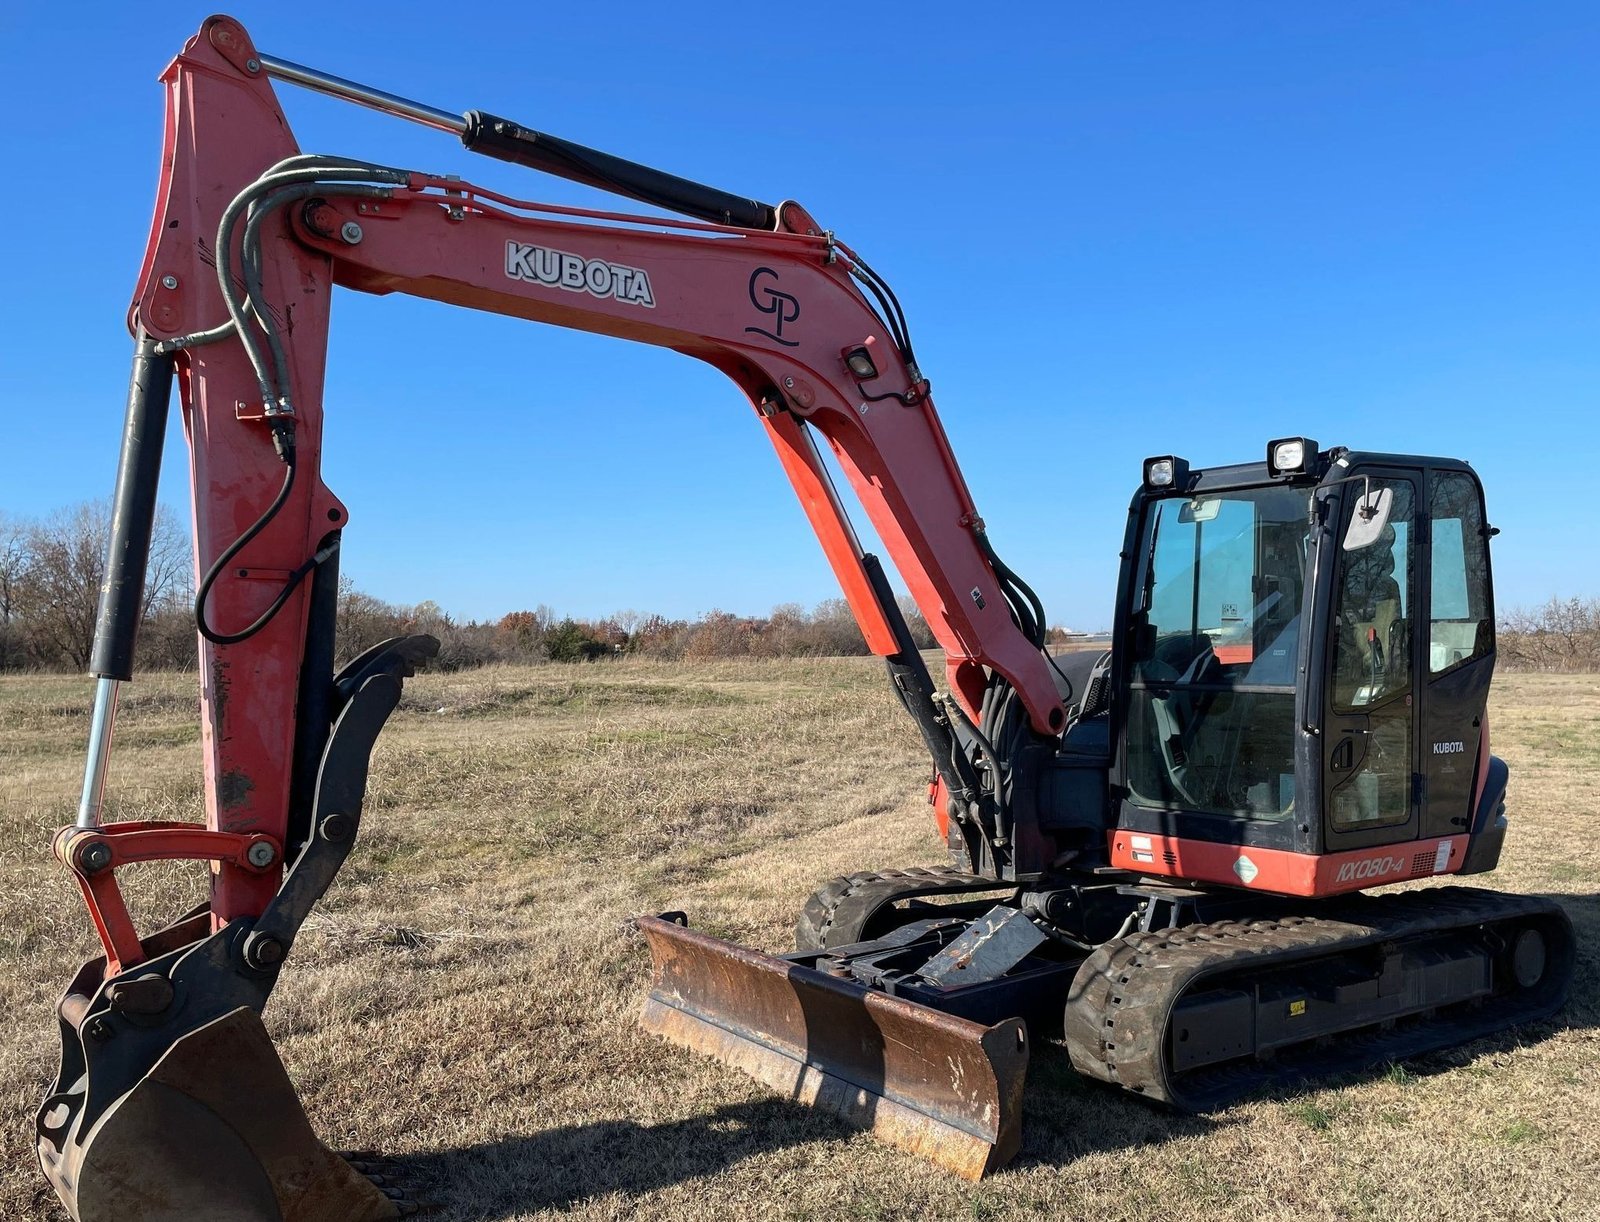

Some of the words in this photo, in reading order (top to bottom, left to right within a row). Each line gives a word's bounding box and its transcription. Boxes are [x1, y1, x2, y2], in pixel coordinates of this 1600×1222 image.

[506, 241, 655, 306] KUBOTA
[748, 267, 800, 337] GP
[1433, 741, 1464, 754] KUBOTA
[1336, 856, 1404, 882] KX080-4
